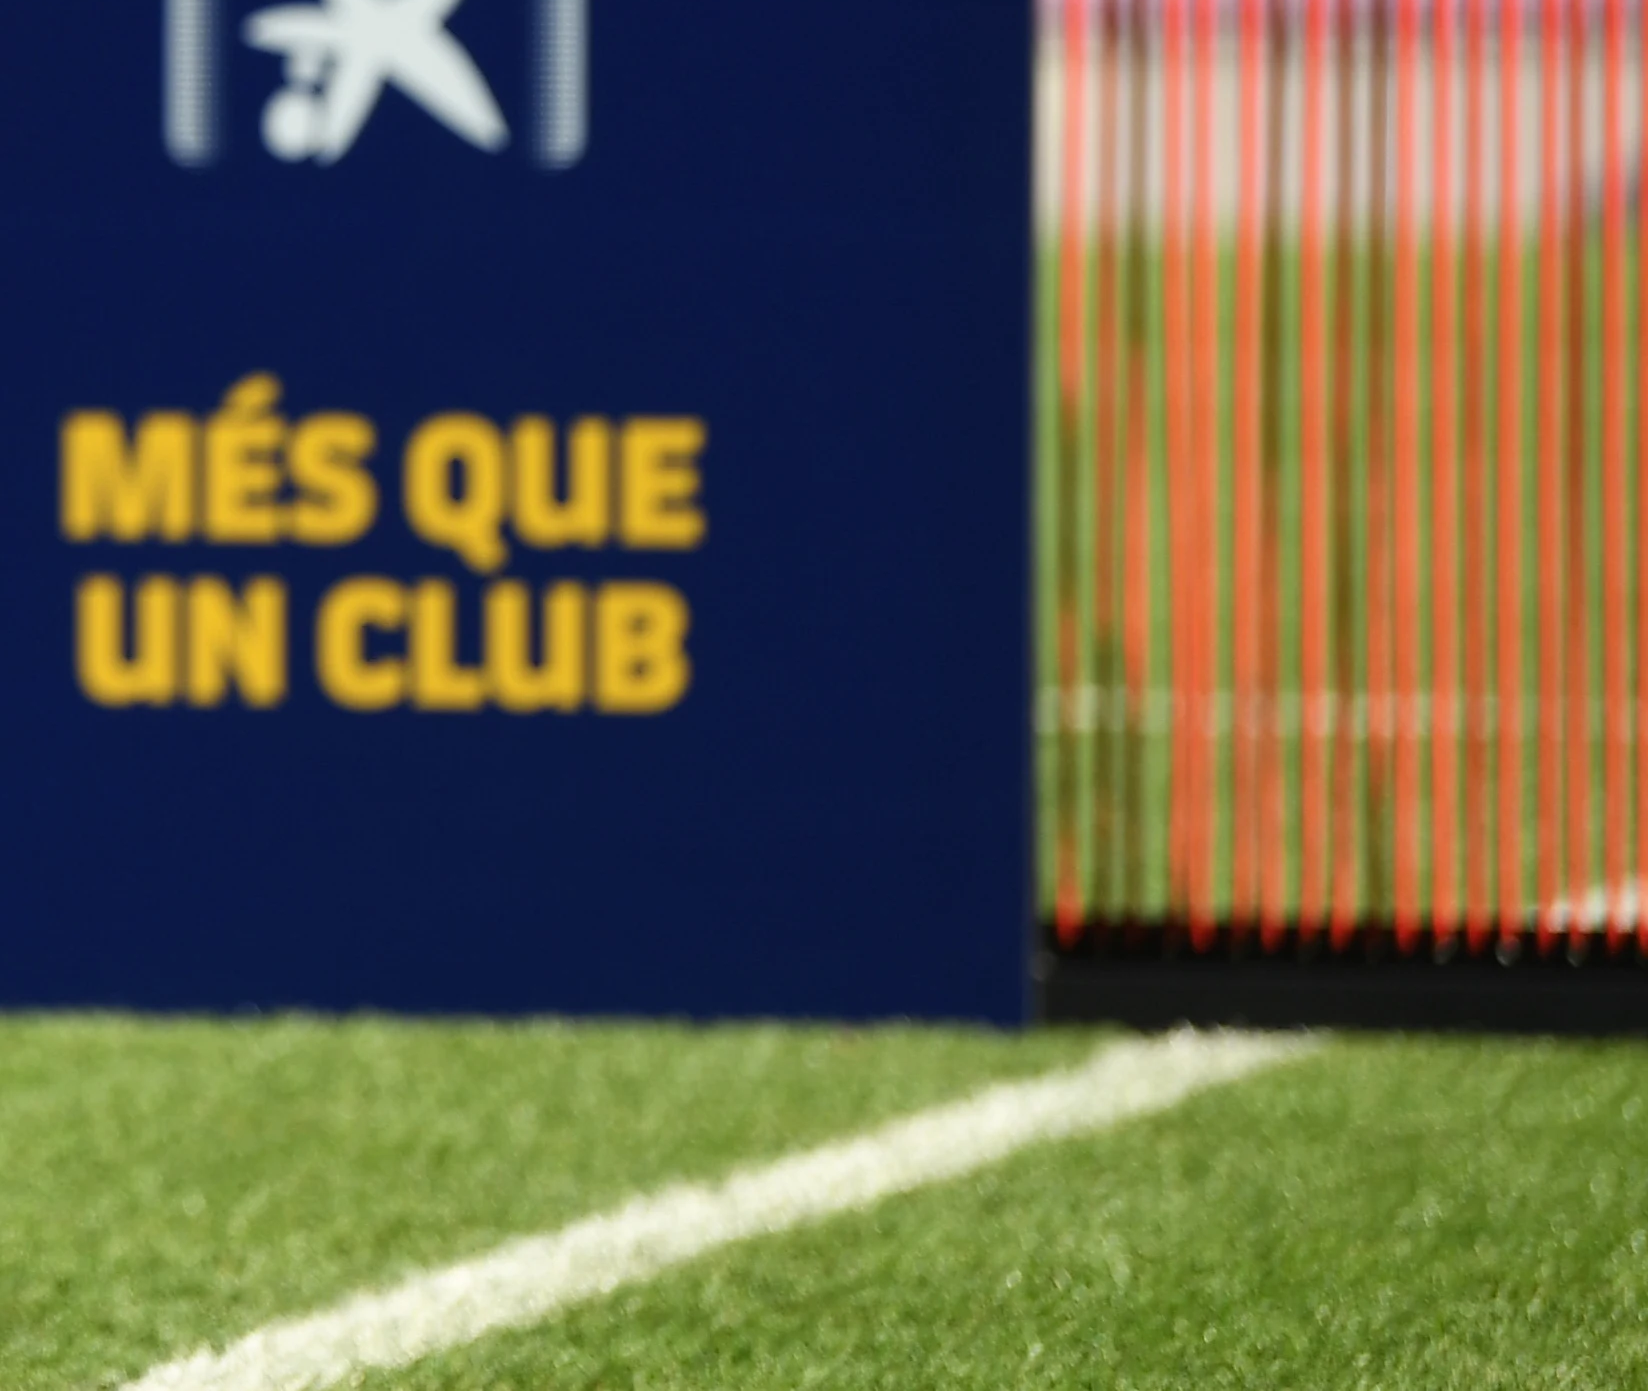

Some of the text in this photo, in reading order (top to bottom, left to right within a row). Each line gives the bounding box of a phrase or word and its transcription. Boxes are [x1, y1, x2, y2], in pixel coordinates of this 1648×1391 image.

[61, 372, 705, 572] MÉS QUE
[75, 575, 690, 713] UN CLUB
